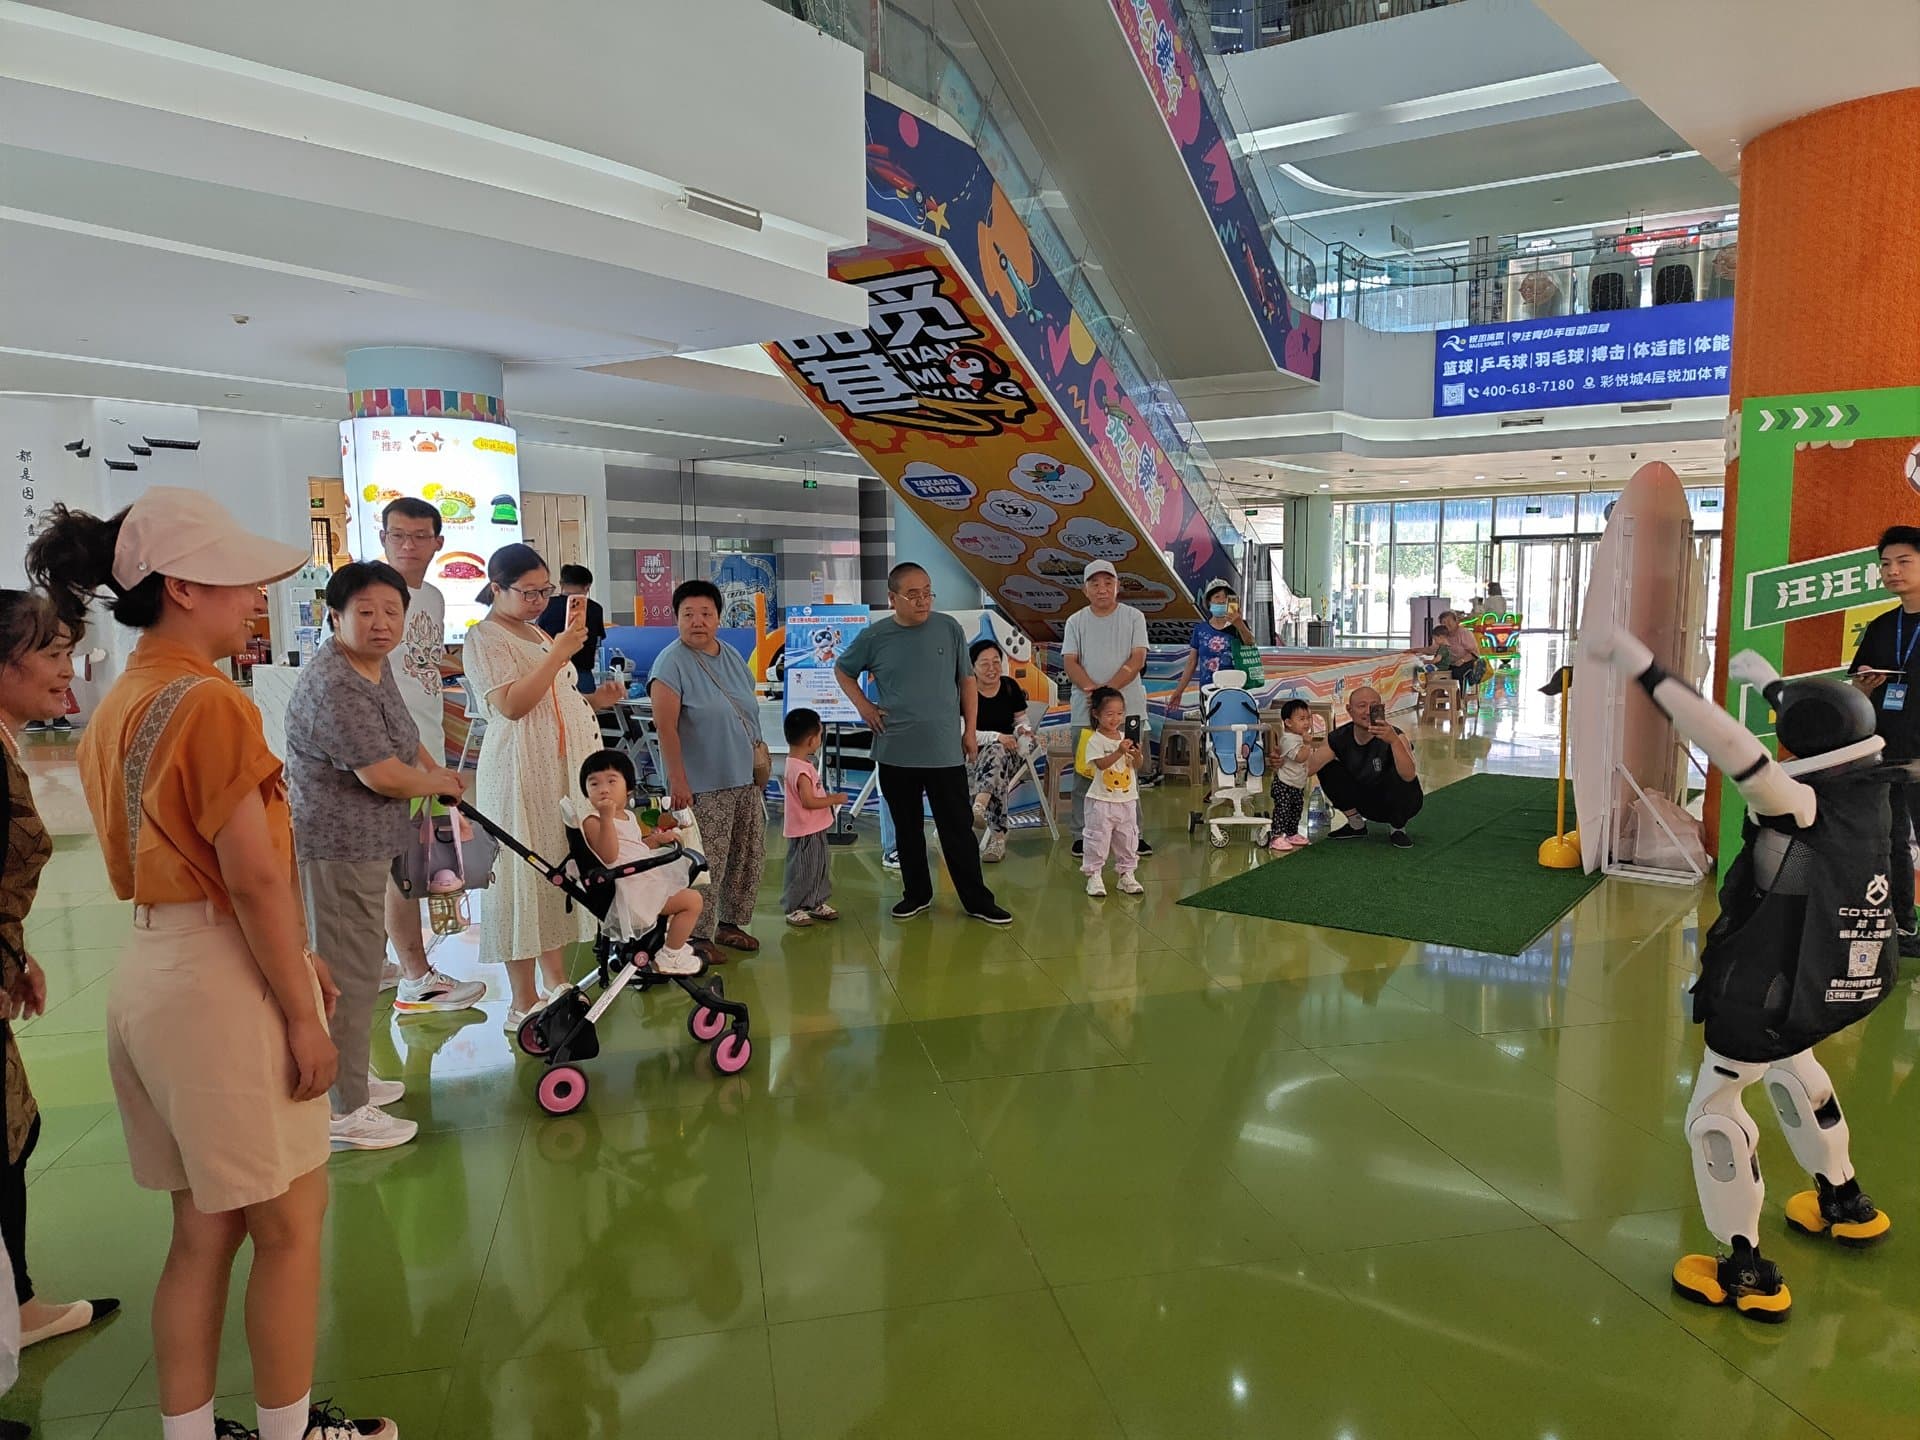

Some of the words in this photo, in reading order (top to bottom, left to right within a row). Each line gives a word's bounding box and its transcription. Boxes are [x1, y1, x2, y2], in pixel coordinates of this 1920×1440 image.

[893, 341, 960, 364] TIAN
[1442, 360, 1474, 377] 篮球
[1479, 354, 1528, 373] 乒乓球
[1534, 348, 1585, 369] 羽毛球
[1591, 344, 1626, 363] 搏击
[1632, 339, 1686, 359] 体适能
[1693, 333, 1731, 353] 体能
[798, 353, 919, 414] 巷
[905, 367, 946, 386] MI
[1599, 364, 1729, 389] 彩悦城4层锐加体育
[1482, 378, 1575, 398] 400-618-7180
[372, 429, 391, 441] 热卖
[381, 441, 401, 452] 推荐
[910, 478, 959, 487] TAKARA
[917, 484, 962, 495] TOMY
